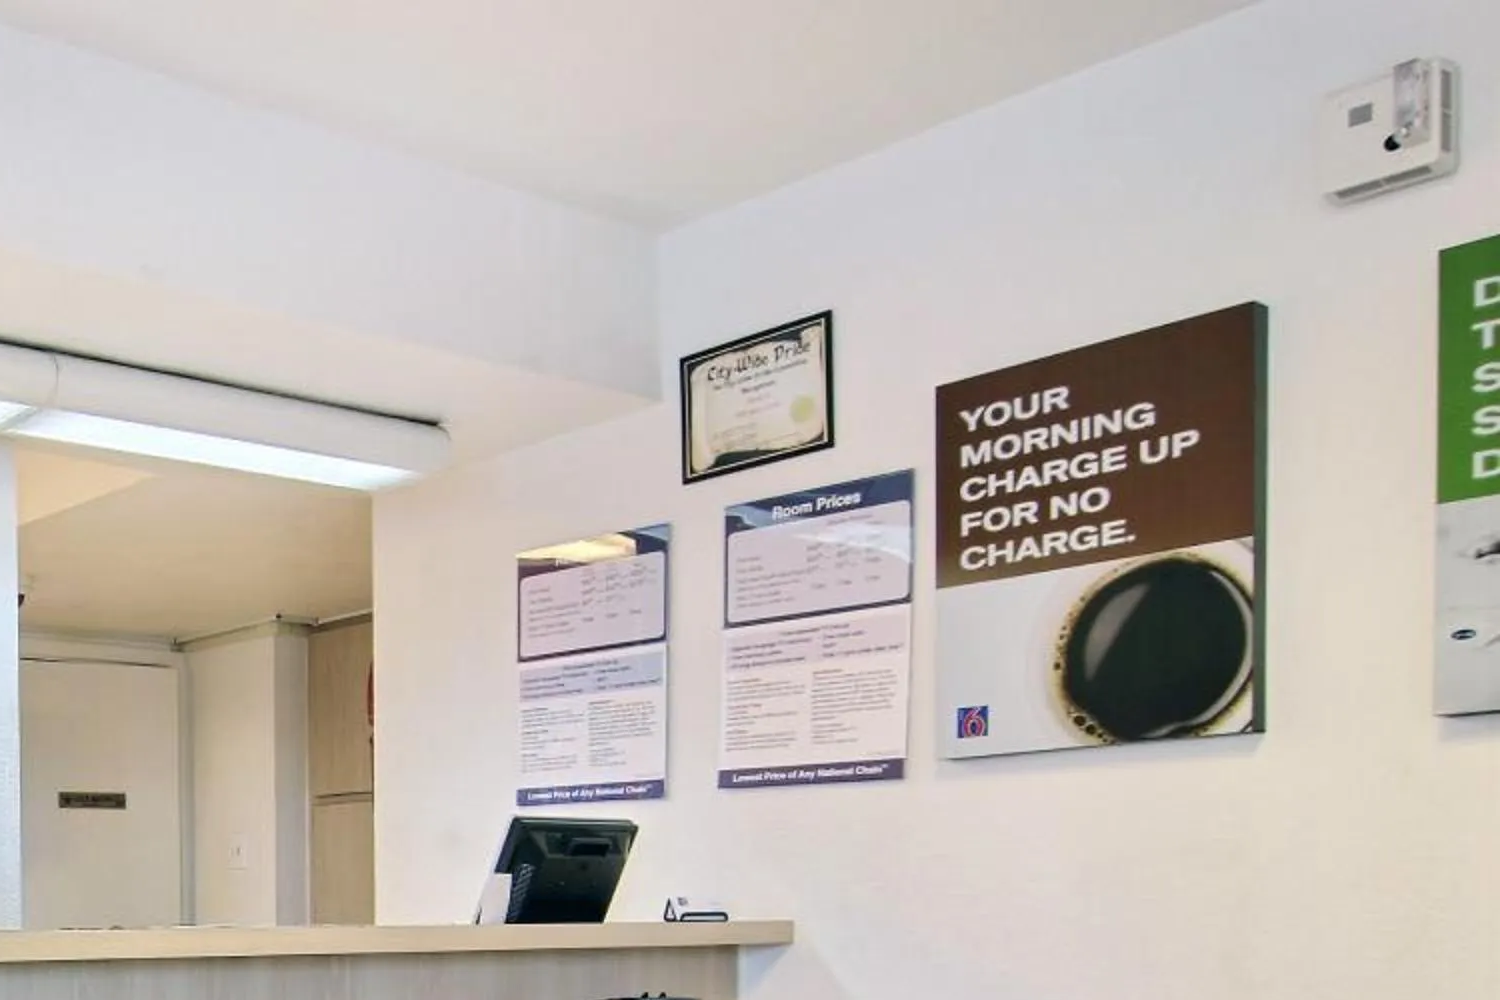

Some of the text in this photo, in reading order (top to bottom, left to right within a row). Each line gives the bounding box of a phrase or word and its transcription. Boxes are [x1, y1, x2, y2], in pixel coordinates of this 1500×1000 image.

[774, 340, 810, 361] Pride
[959, 386, 1071, 432] YOUR
[960, 402, 1156, 468] MORNING
[959, 429, 1200, 502] CHARGE UP
[772, 492, 862, 520] Room Prices
[960, 487, 1111, 537] FOR NO
[959, 519, 1136, 571] CHARGE.
[764, 771, 786, 781] Price
[788, 769, 797, 779] of
[798, 768, 816, 780] Any
